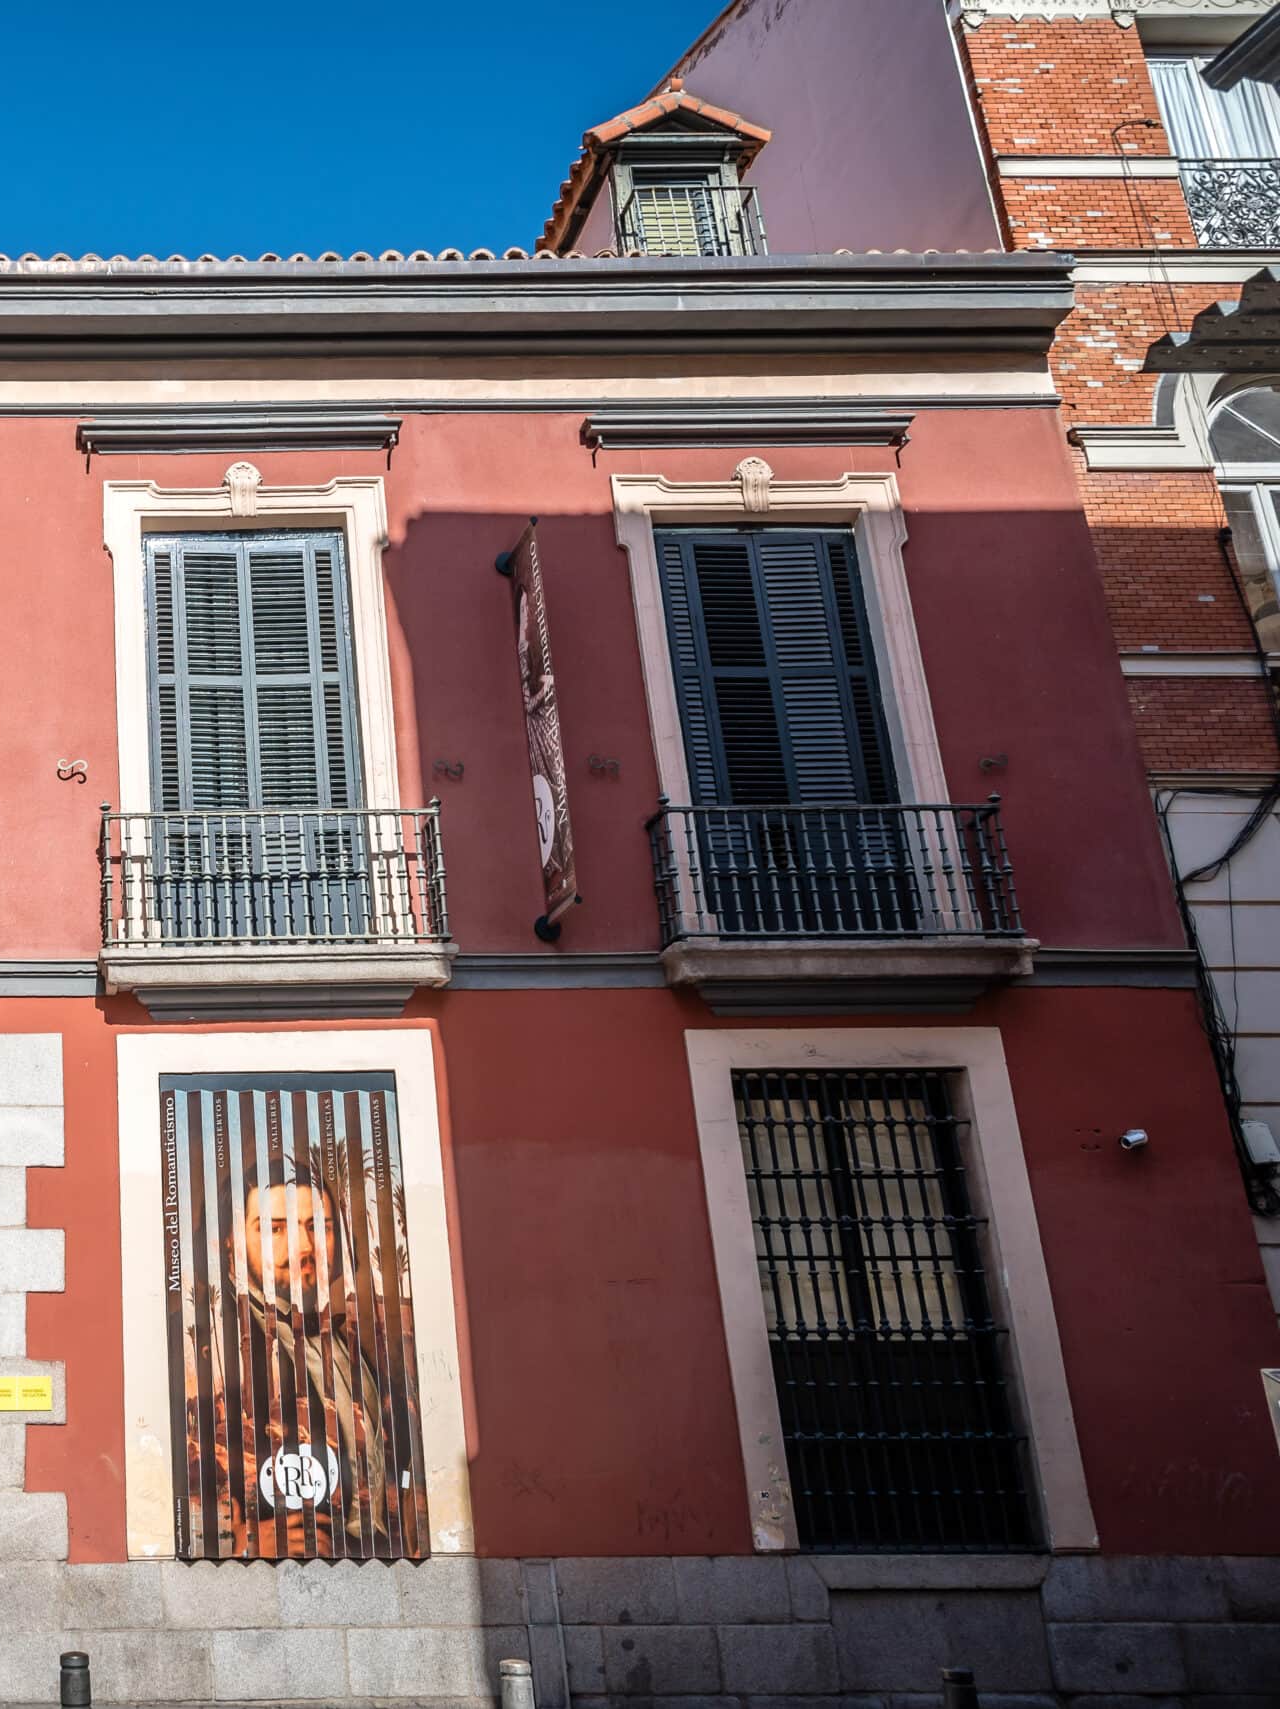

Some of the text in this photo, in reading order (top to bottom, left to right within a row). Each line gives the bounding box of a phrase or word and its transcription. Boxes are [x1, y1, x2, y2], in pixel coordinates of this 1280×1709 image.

[216, 1098, 225, 1168] CONCIERTOS
[269, 1098, 279, 1151] TALLERES
[324, 1098, 336, 1181] CONFERENCIAS
[372, 1099, 385, 1190] VISITAS GUIADAS
[163, 1097, 182, 1292] Museo del Romanticismo
